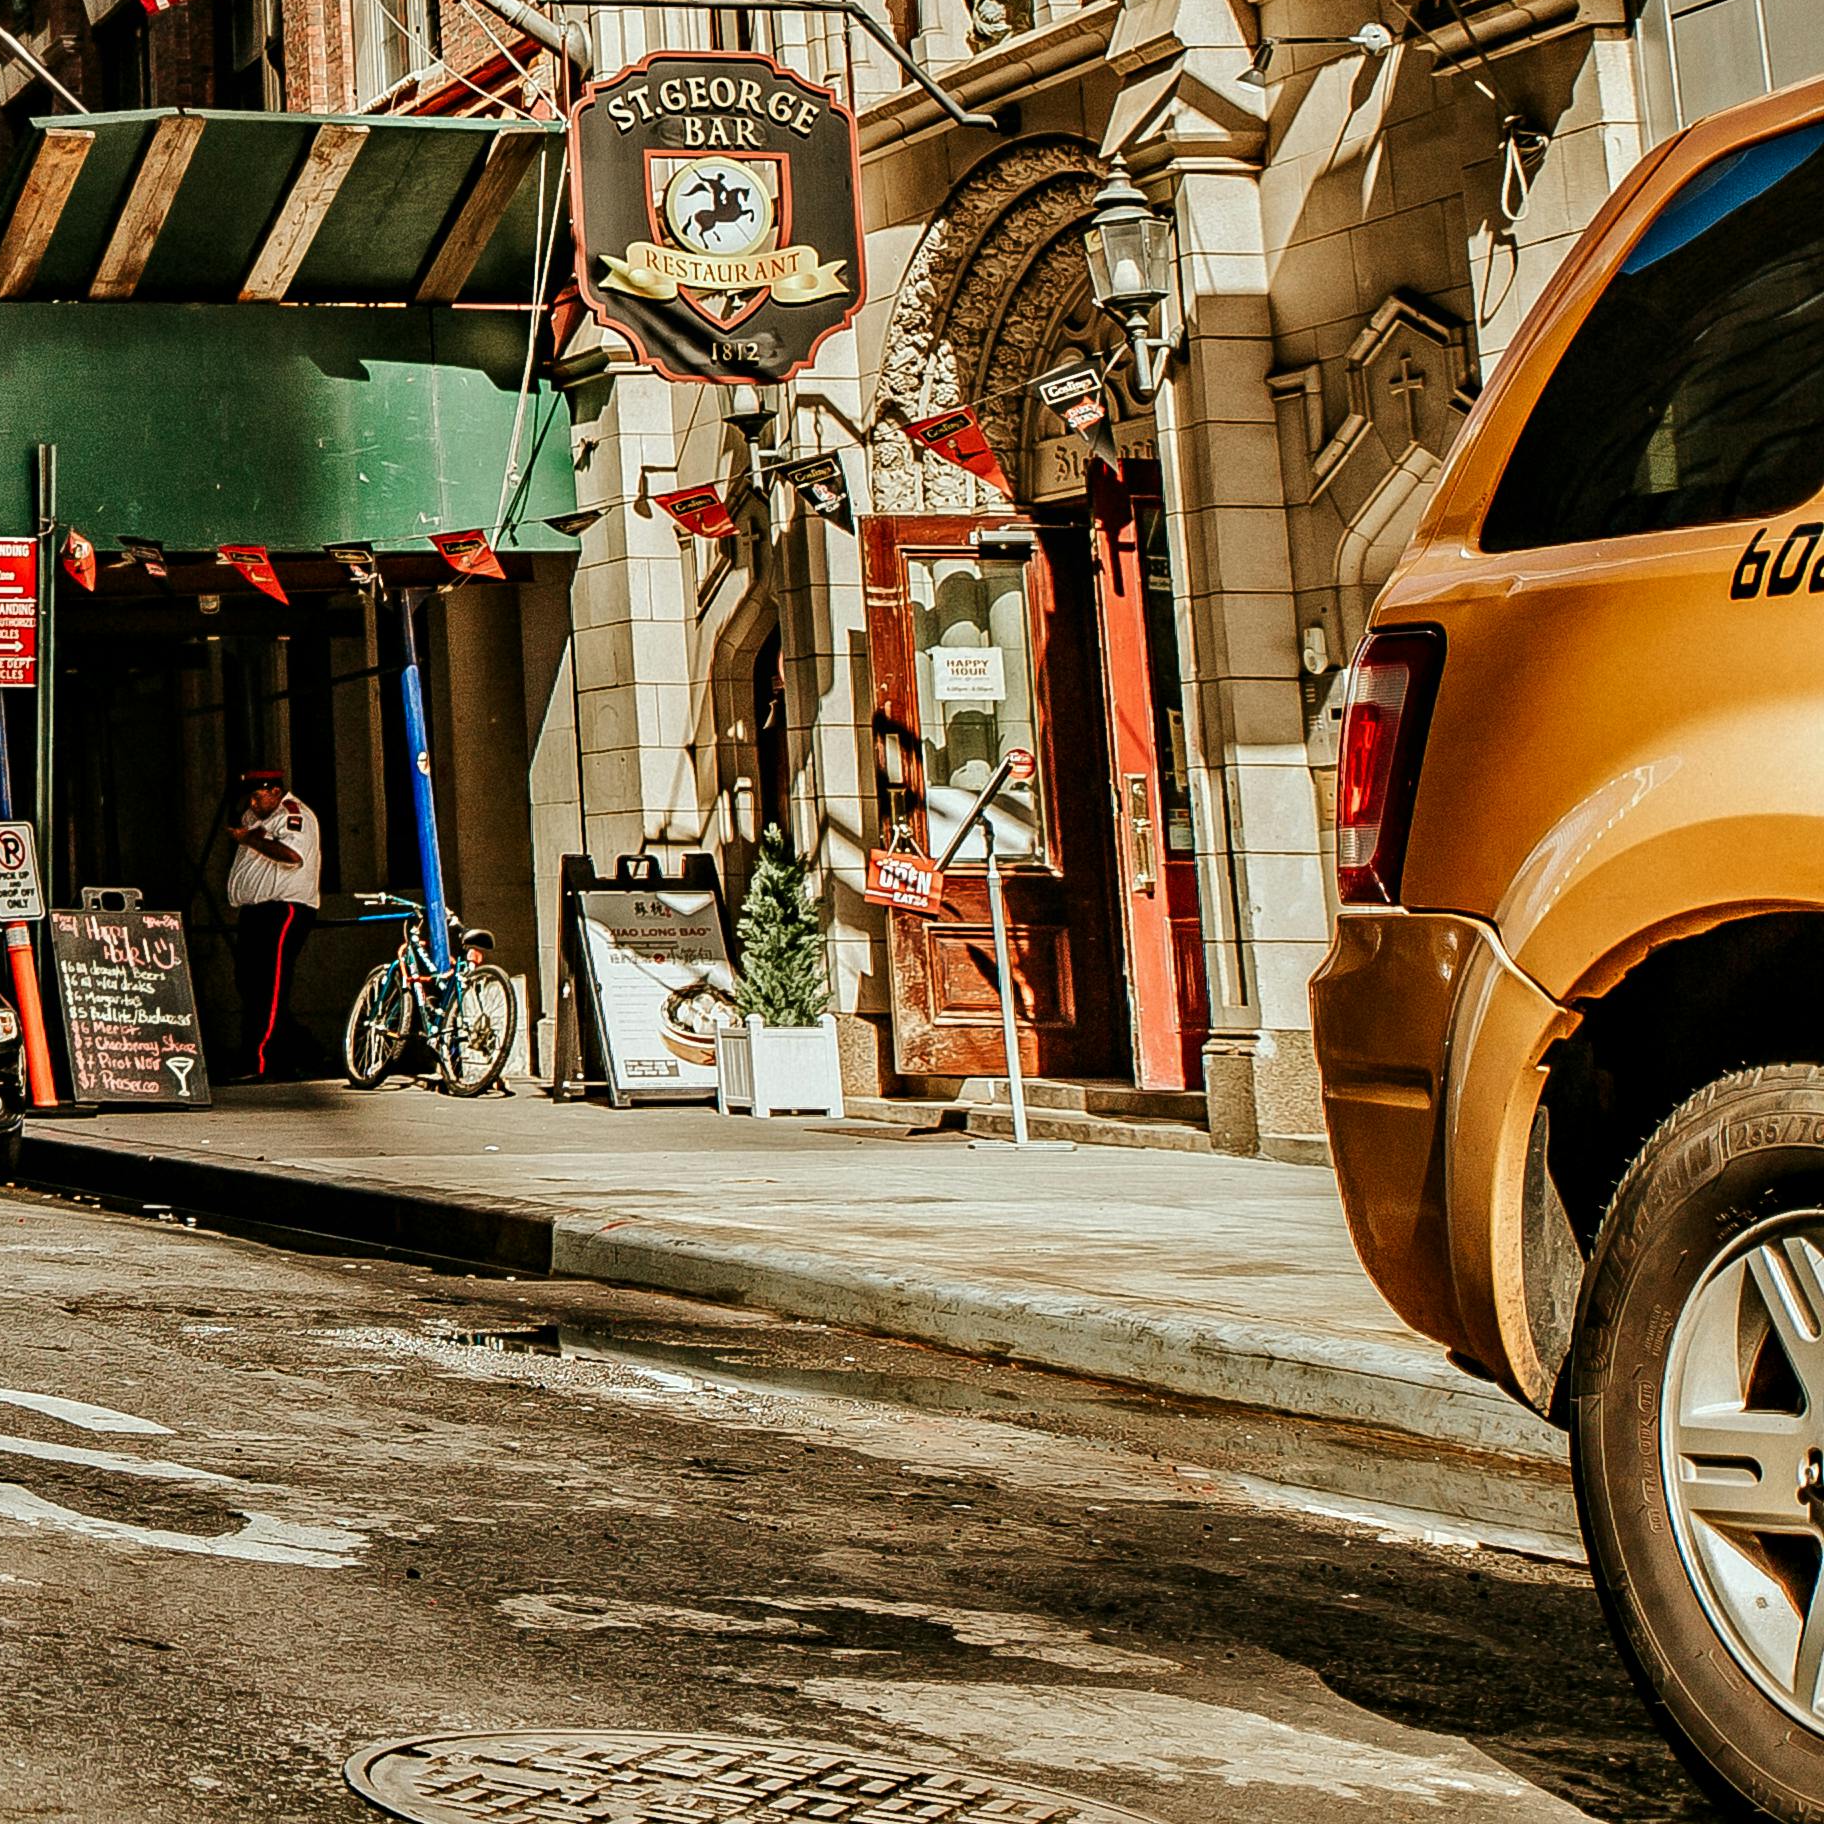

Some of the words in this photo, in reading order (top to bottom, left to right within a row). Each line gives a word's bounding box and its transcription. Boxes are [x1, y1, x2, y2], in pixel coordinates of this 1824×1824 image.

[683, 116, 761, 147] BAR
[645, 249, 802, 284] RESTAURANT
[711, 342, 761, 362] 1812
[946, 659, 990, 668] HAPPY
[951, 667, 987, 676] HOUR
[19, 870, 30, 880] UP
[879, 865, 933, 896] OPEN
[7, 898, 29, 910] ONLY
[641, 927, 677, 937] LONG
